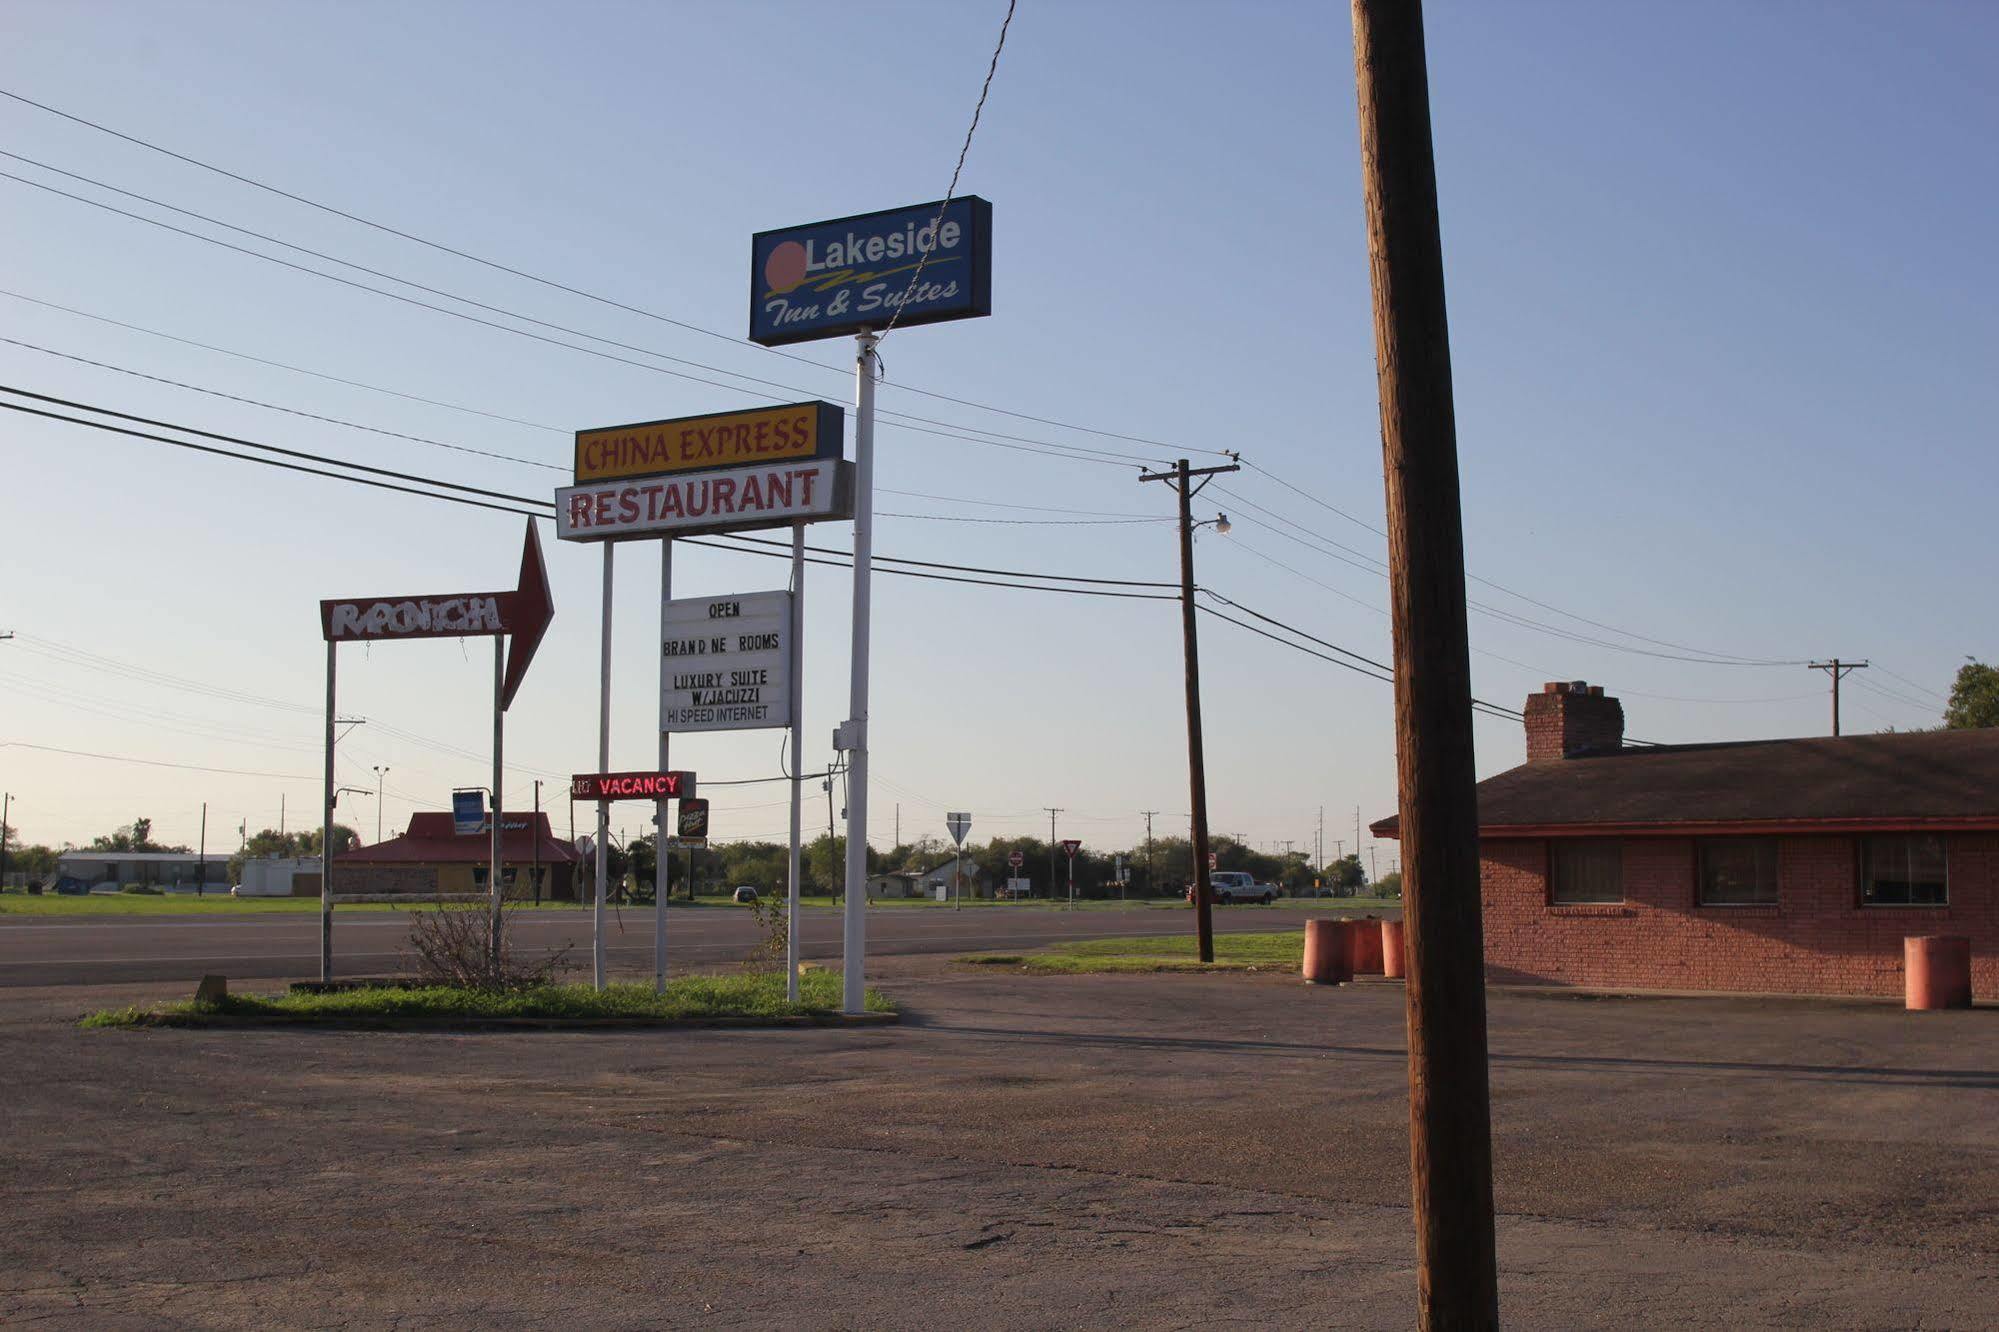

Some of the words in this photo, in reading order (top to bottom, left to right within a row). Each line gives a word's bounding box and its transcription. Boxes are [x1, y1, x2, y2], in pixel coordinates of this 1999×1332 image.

[805, 218, 961, 272] Lakeside
[765, 299, 820, 327] Inn
[826, 290, 850, 317] &
[857, 280, 959, 312] Suites
[584, 432, 670, 471] CHINA
[680, 416, 809, 461] EXPRESS
[569, 468, 819, 529] RESTAURANT
[709, 602, 740, 618] OPEN
[663, 639, 706, 656] BRAND
[711, 637, 726, 653] NE
[739, 633, 779, 651] ROOMS
[674, 672, 723, 690] LUXURY
[731, 670, 767, 686] SUITE
[692, 687, 760, 706] W/JACUZZI
[667, 709, 678, 723] HI
[680, 707, 714, 723] SPEED
[716, 705, 768, 722] INTERNET
[600, 776, 677, 794] VACANCY
